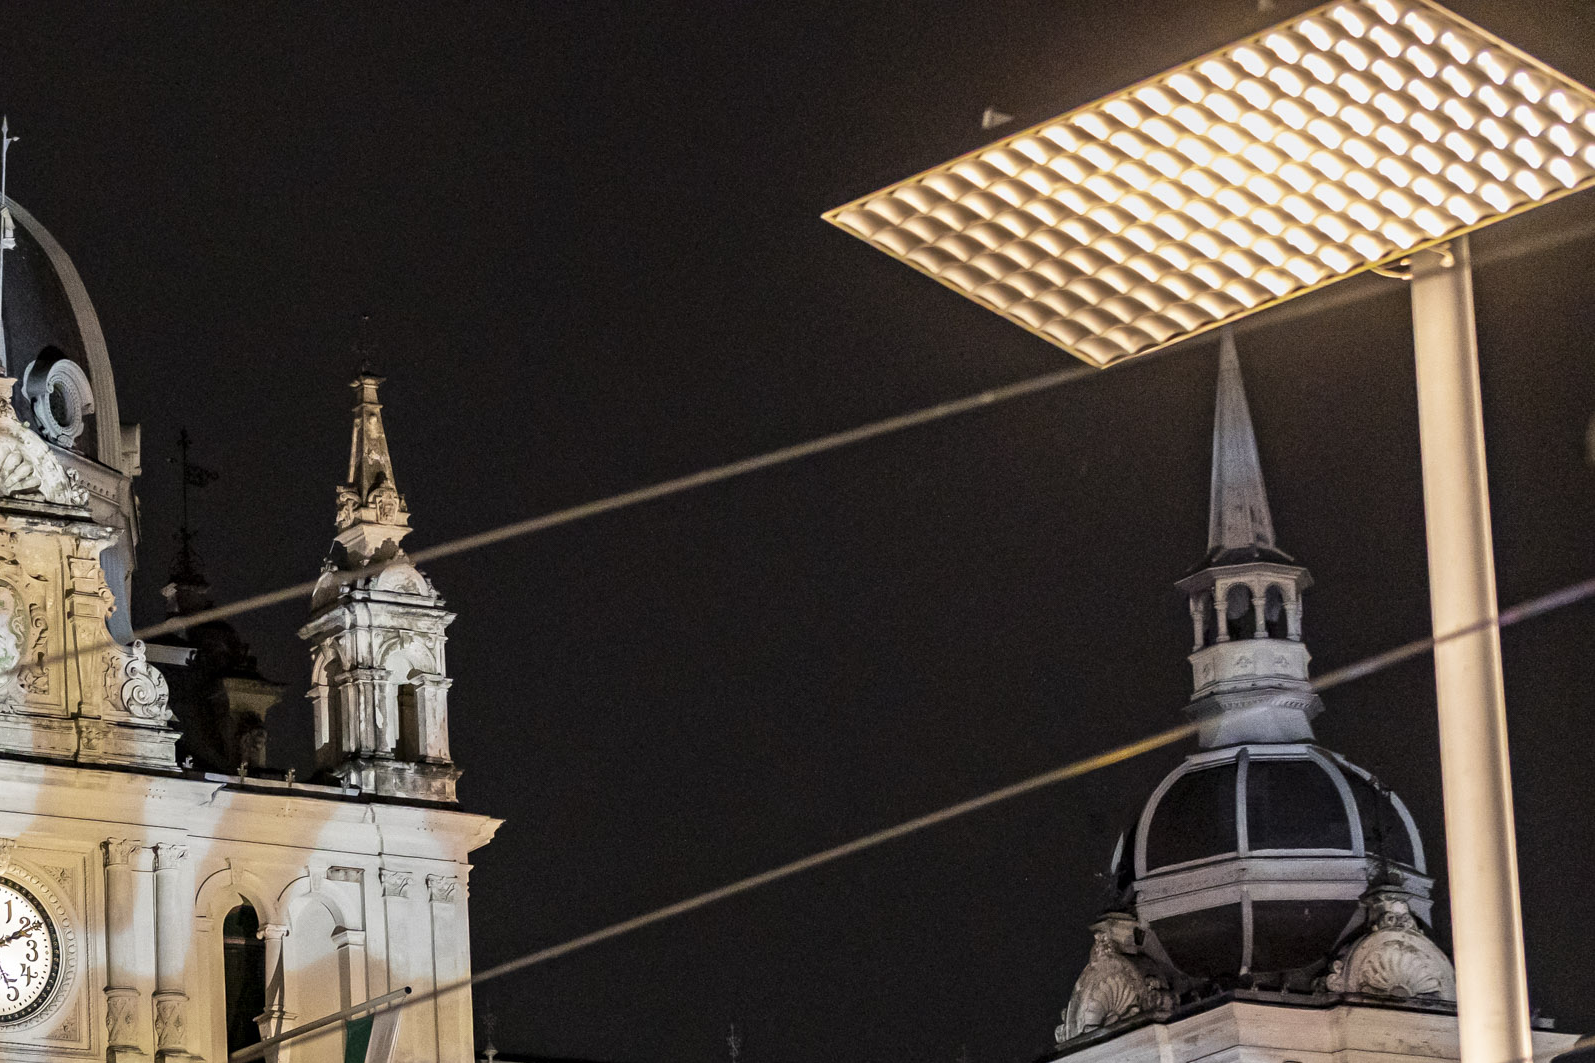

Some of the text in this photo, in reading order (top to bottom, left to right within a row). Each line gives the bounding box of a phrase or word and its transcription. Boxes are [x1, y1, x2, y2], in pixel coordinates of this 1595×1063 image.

[4, 900, 12, 924] 1
[19, 916, 32, 937] 2
[26, 940, 38, 961] 3
[20, 963, 38, 987] 4
[6, 979, 19, 1001] 5
